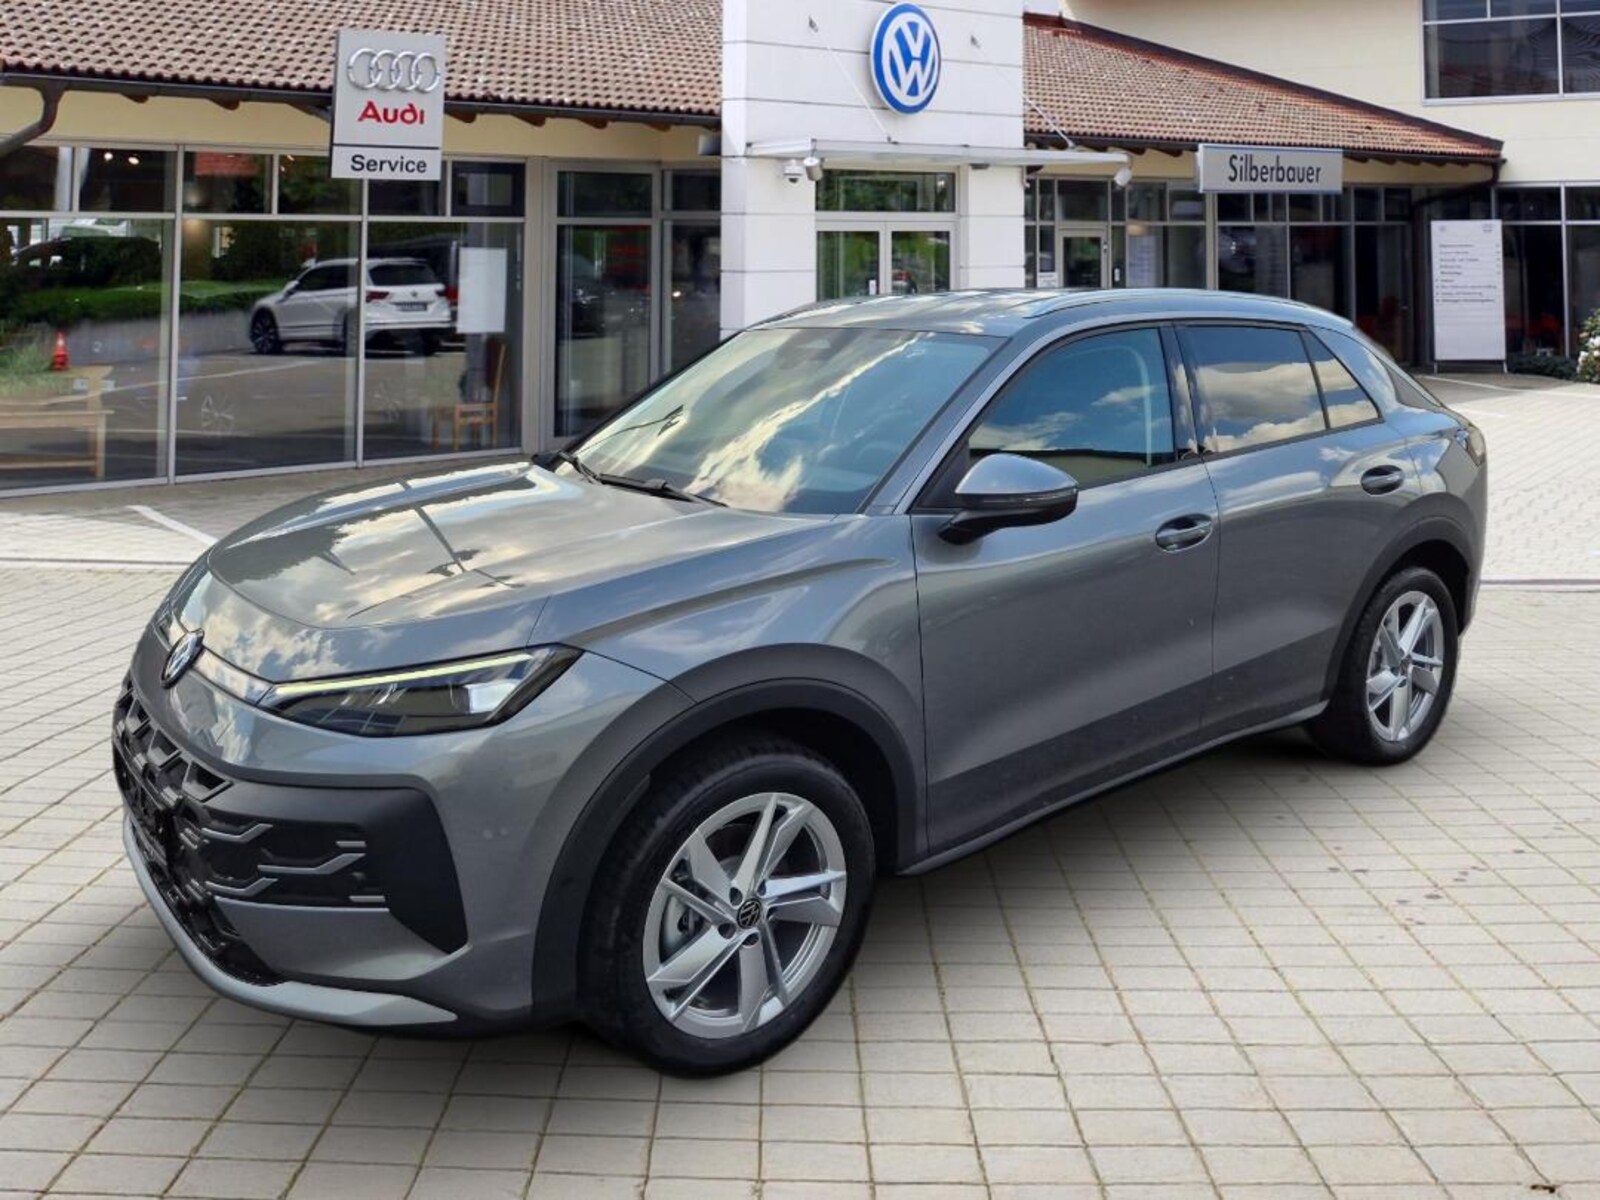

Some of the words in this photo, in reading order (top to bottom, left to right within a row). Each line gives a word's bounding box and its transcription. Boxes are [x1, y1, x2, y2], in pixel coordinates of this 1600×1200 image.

[358, 100, 425, 125] Audi
[350, 153, 427, 173] Service
[1228, 153, 1321, 183] Silberbauer
